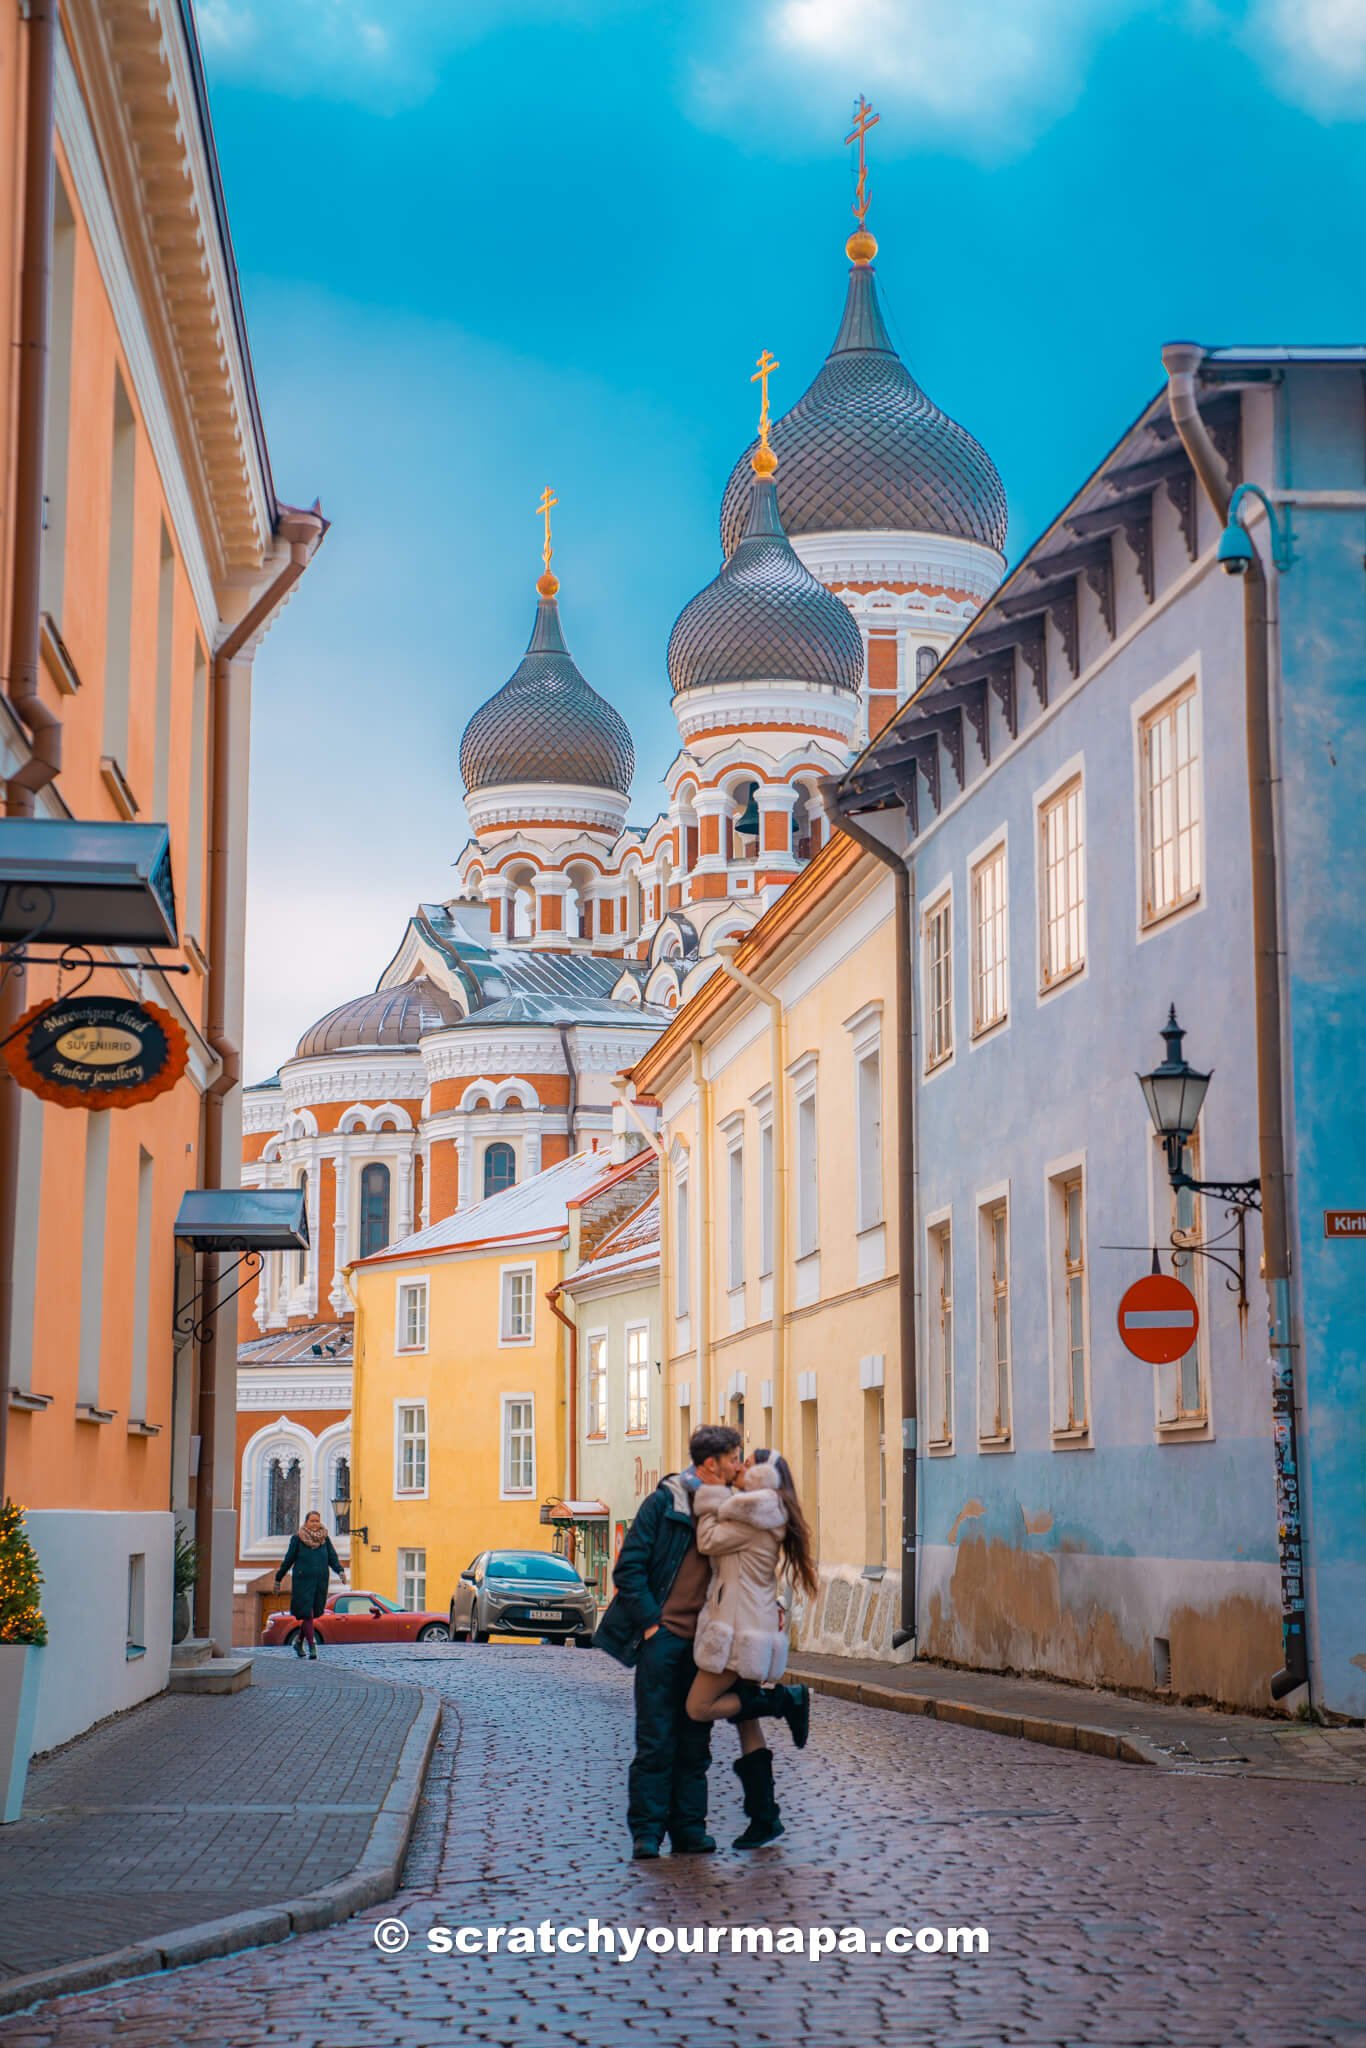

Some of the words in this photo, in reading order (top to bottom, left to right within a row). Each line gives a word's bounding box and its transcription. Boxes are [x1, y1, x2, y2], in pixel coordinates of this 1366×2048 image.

[66, 1040, 132, 1052] SUVENIIRID
[52, 1062, 90, 1081] Amber
[90, 1064, 144, 1087] jewellery
